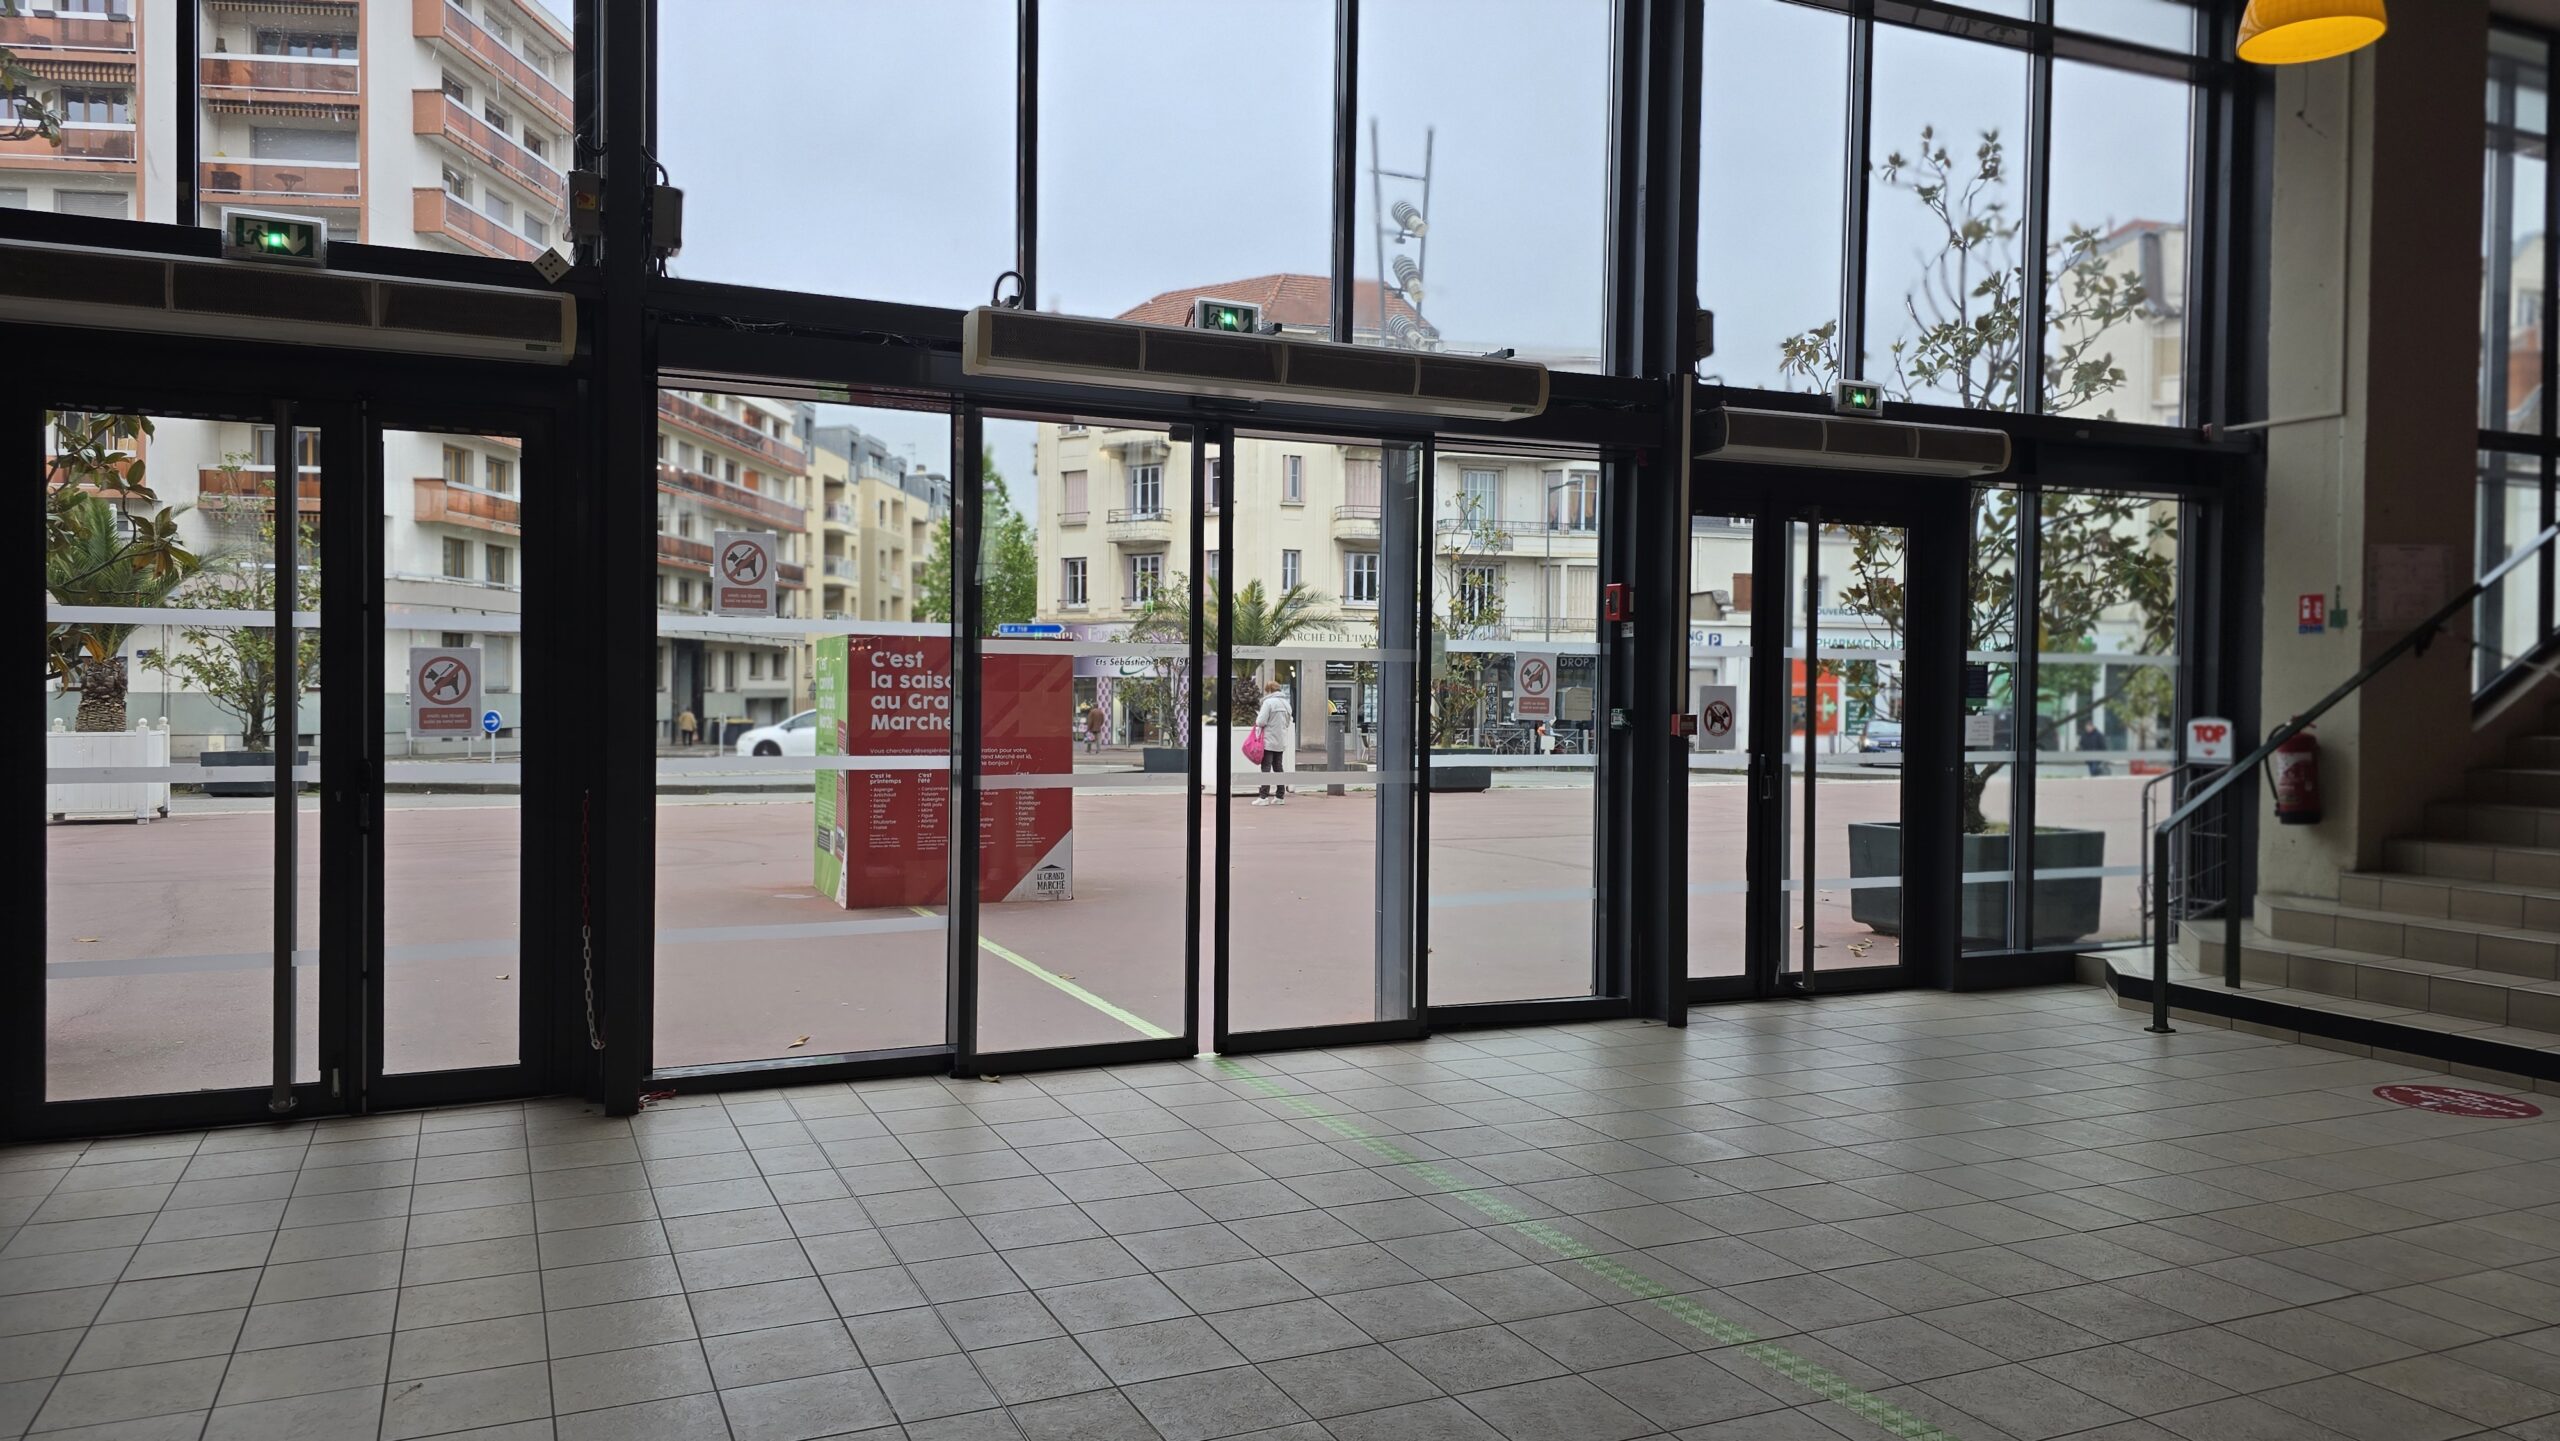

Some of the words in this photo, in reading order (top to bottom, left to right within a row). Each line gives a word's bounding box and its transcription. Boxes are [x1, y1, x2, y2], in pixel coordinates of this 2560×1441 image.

[1329, 633, 1343, 642] DE
[871, 651, 924, 668] C'est
[1095, 658, 1107, 666] Ets
[1560, 657, 1590, 667] DROP
[871, 671, 892, 689] la
[871, 695, 900, 710] au
[2193, 724, 2226, 743] TOP
[1043, 872, 1065, 881] GRAND
